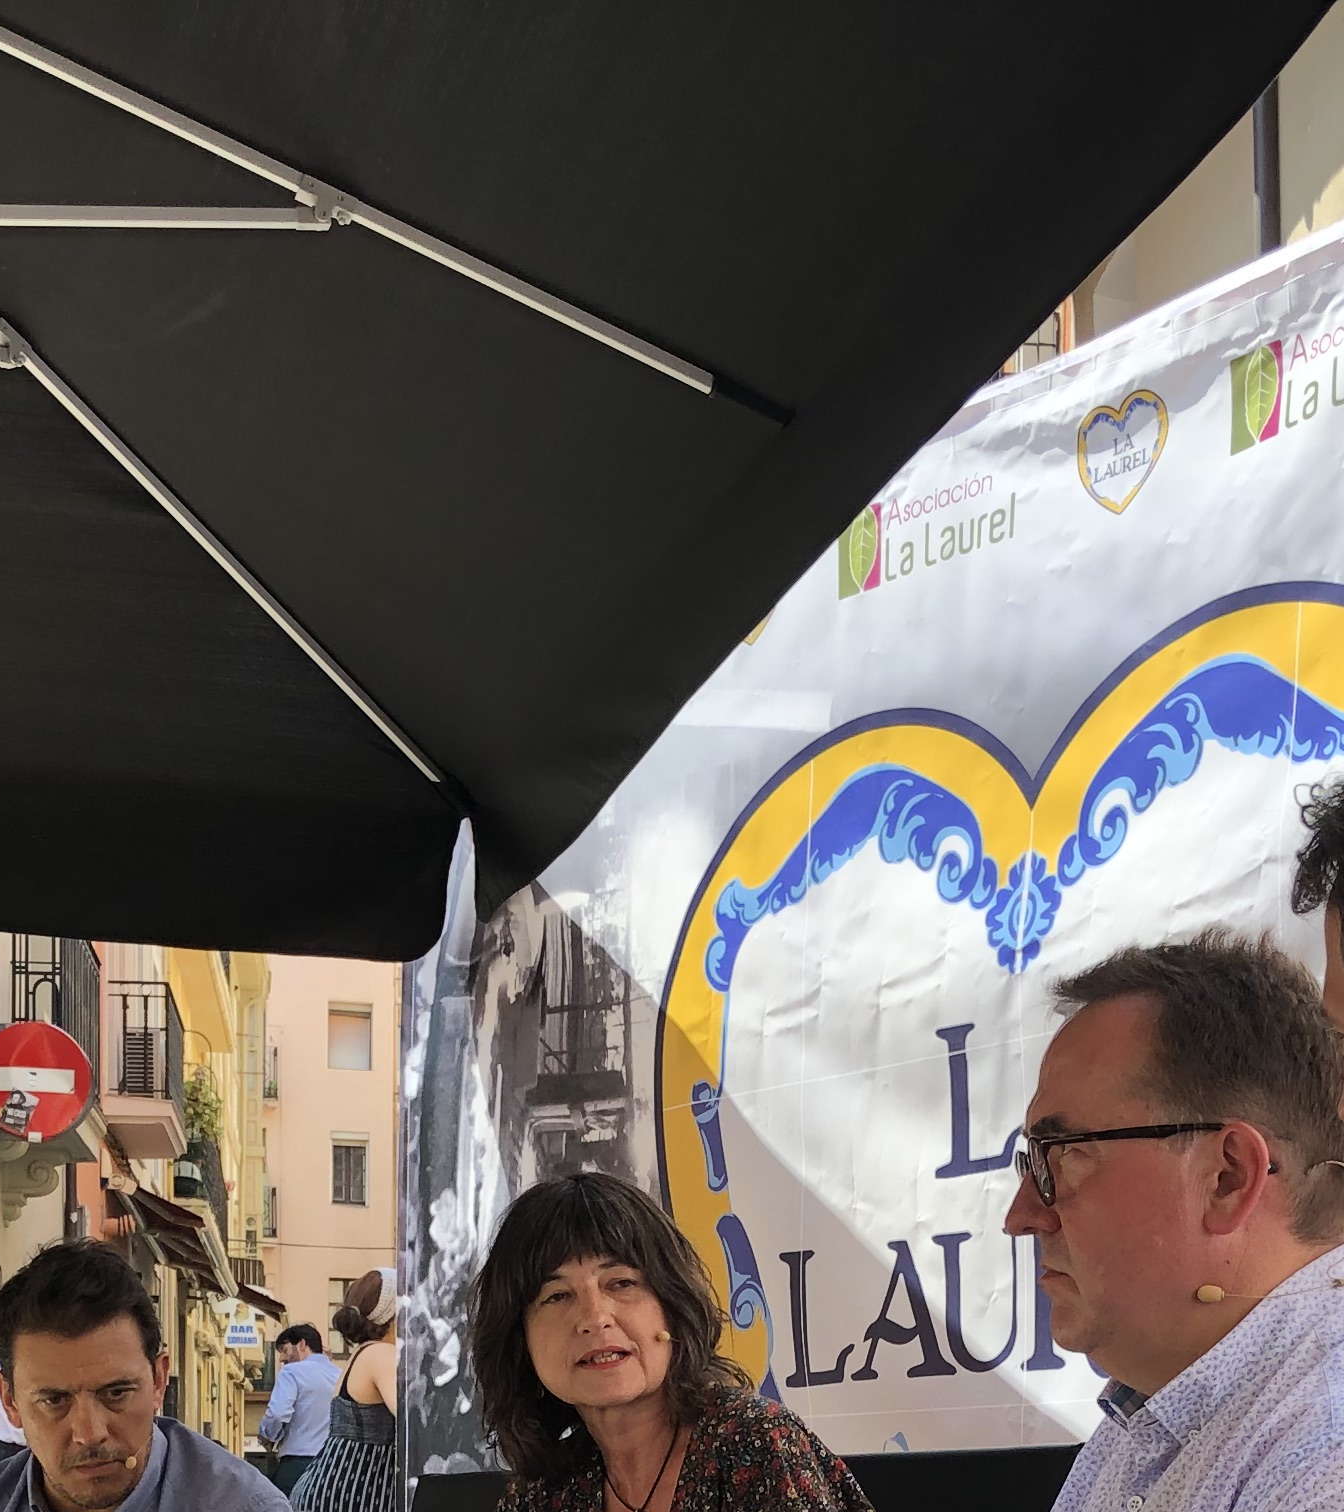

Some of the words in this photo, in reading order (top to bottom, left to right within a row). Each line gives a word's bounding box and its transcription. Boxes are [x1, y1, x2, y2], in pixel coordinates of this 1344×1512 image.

[1285, 379, 1319, 428] La
[1093, 448, 1151, 484] LAUREL
[1112, 433, 1135, 457] LA
[886, 472, 994, 531] Asociación
[885, 537, 915, 582] La
[924, 492, 1016, 567] Laurel
[935, 1022, 1024, 1180] L
[231, 1325, 254, 1334] BAR
